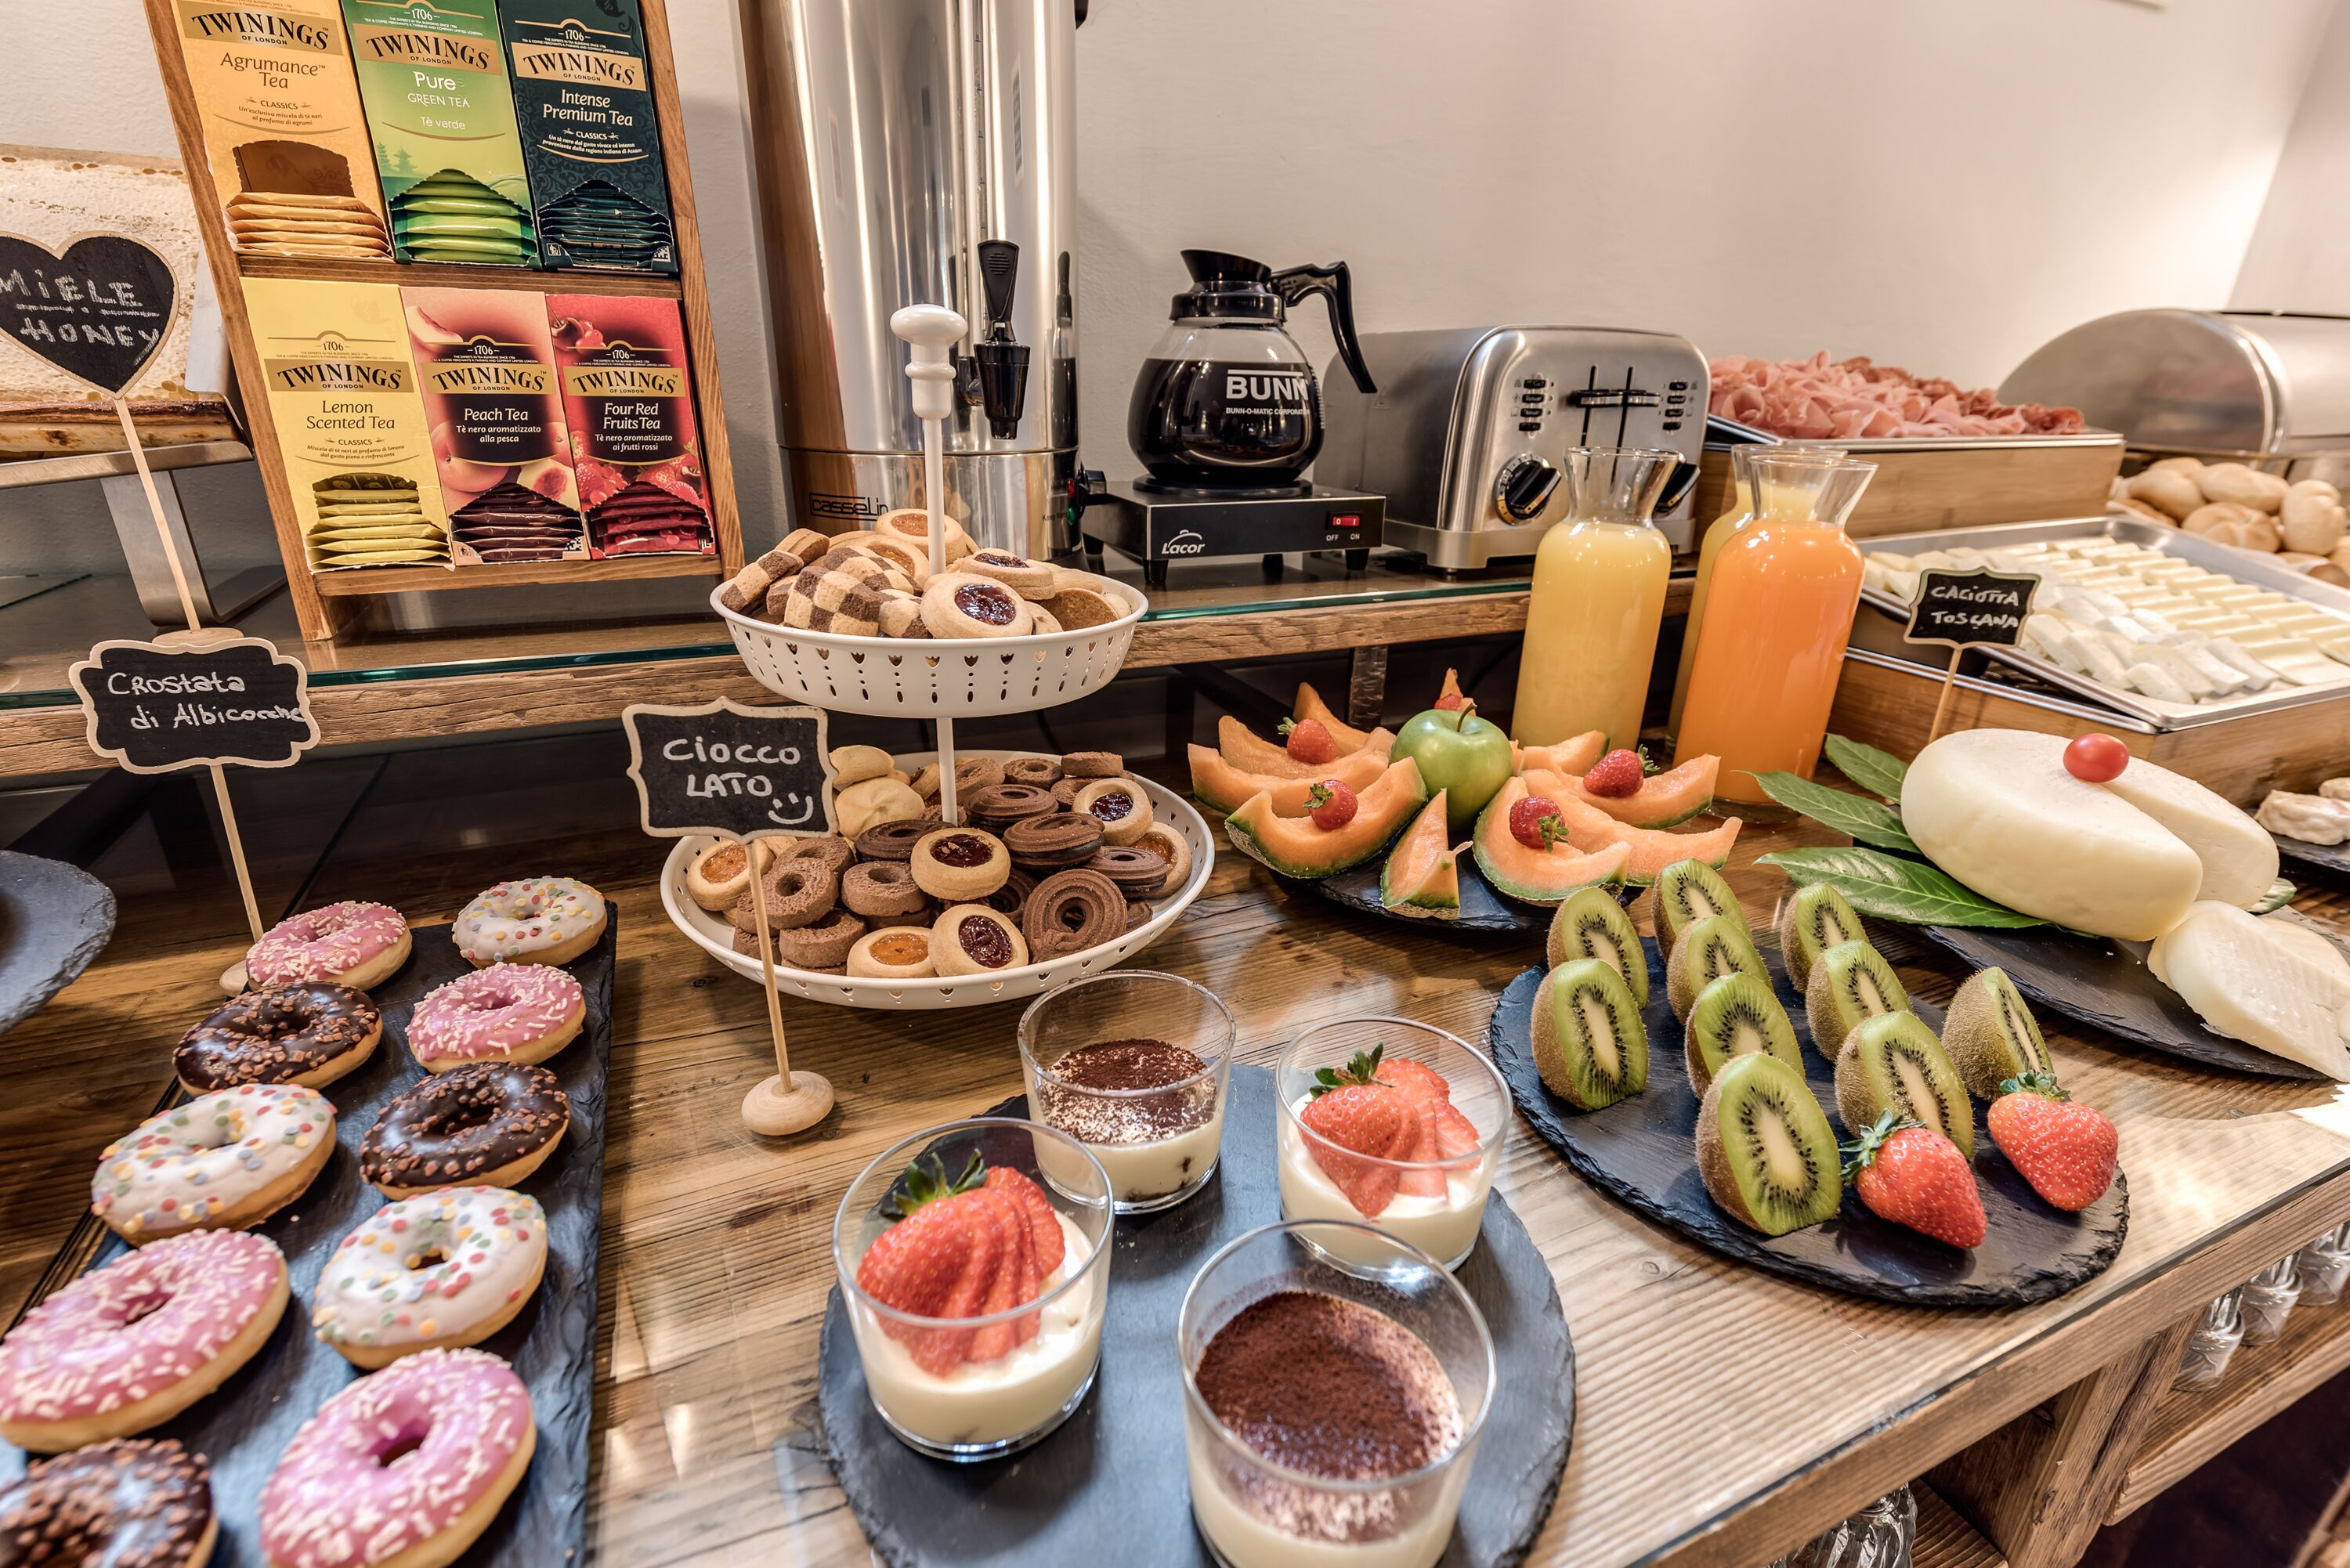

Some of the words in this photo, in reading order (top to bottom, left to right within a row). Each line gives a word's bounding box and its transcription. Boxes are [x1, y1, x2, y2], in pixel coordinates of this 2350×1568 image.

[412, 8, 433, 20] 1706
[255, 37, 288, 45] LONDON
[566, 29, 584, 41] 1706
[259, 72, 289, 89] Tea
[414, 70, 457, 90] Pure
[261, 99, 298, 110] CLASSICS
[408, 93, 446, 107] GREEN
[448, 96, 471, 109] TEA
[561, 89, 611, 107] Intense
[543, 103, 606, 123] Premium
[609, 110, 634, 126] Tea
[421, 117, 432, 127] Tè
[436, 117, 466, 130] verde
[576, 131, 608, 140] CLASSICS
[20, 317, 160, 366] HONEY
[324, 341, 344, 351] 1706
[474, 345, 494, 356] 1706
[612, 349, 630, 359] 1706
[1226, 376, 1309, 400] BUNN
[323, 400, 374, 414] Lemon
[604, 403, 634, 415] Four
[635, 403, 659, 415] Red
[465, 408, 503, 421] Peach
[505, 408, 529, 421] Tea
[306, 416, 365, 429] Scented
[369, 416, 396, 429] Tea
[457, 425, 467, 433] Tè
[487, 425, 541, 433] aromatizzato
[603, 417, 638, 430] Fruits
[639, 417, 660, 430] Tea
[497, 435, 519, 445] pesca
[620, 443, 640, 452] frutti
[1161, 542, 1206, 555] Lacor
[131, 705, 158, 729] di
[686, 771, 772, 797] LATO
